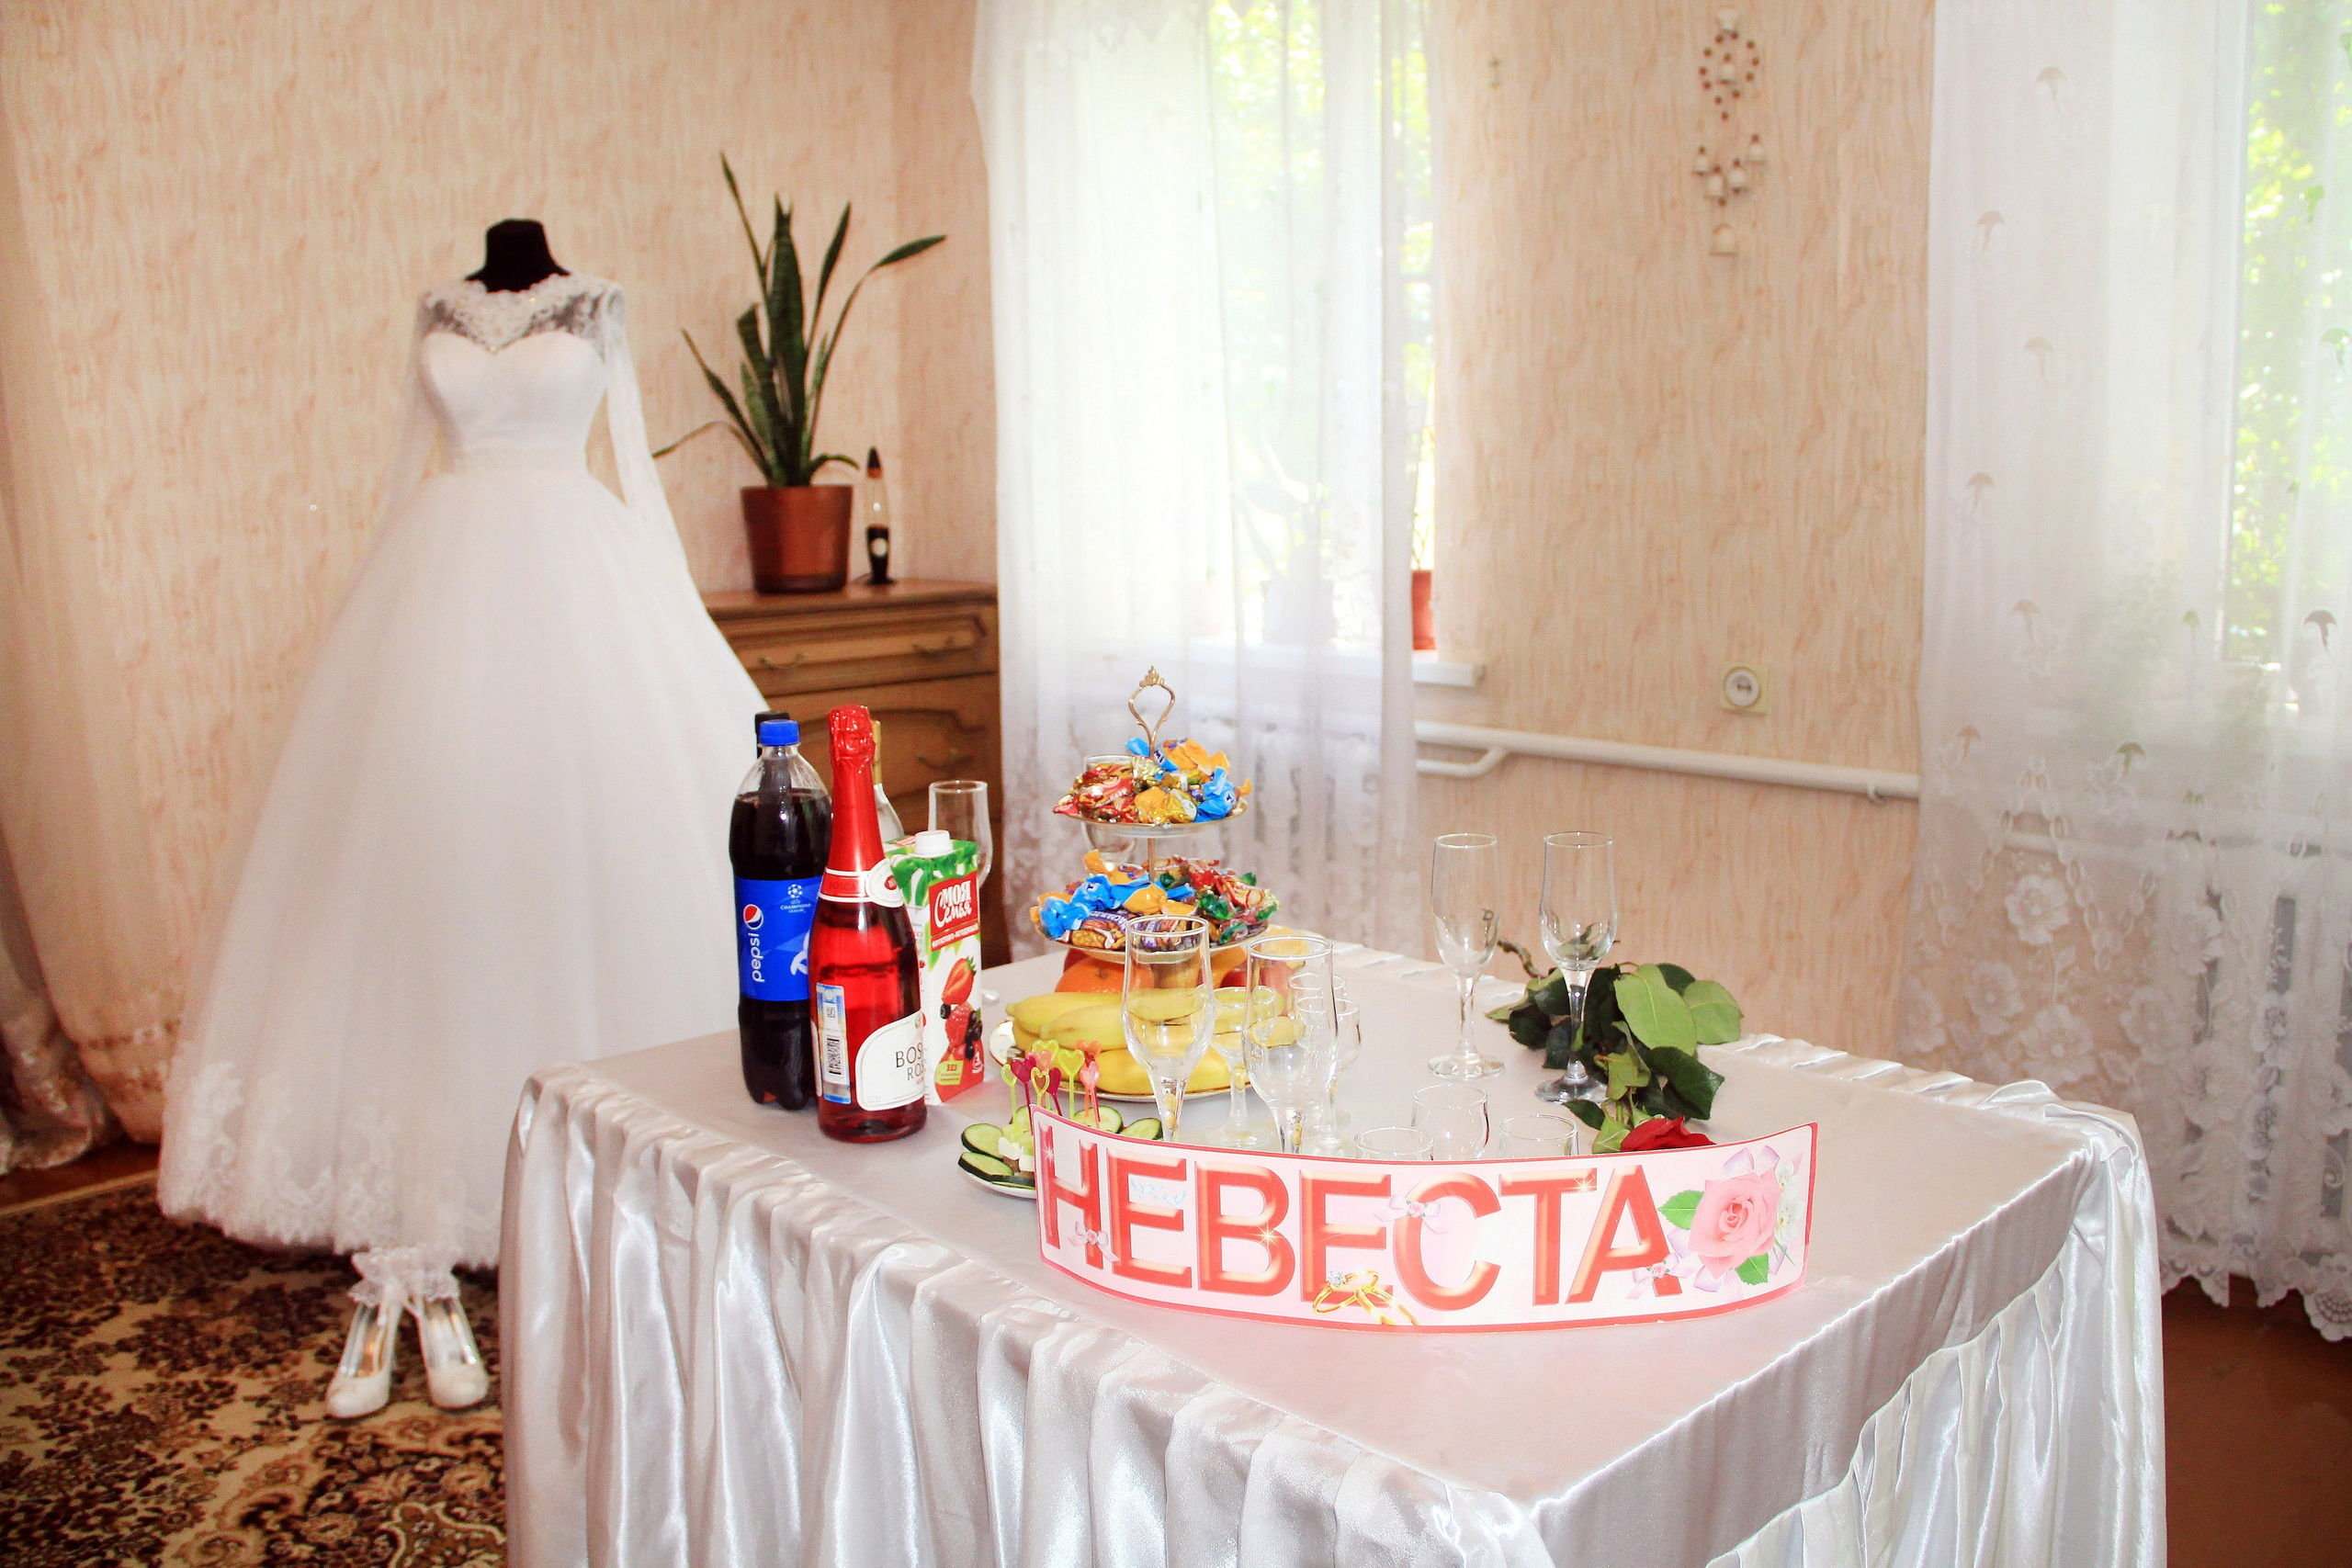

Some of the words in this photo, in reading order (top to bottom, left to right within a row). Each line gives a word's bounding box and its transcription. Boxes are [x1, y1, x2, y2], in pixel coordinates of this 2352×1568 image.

[939, 880, 971, 909] МОЯ
[748, 931, 765, 983] pepsi
[1038, 1122, 1683, 1313] НЕВЕСТА
